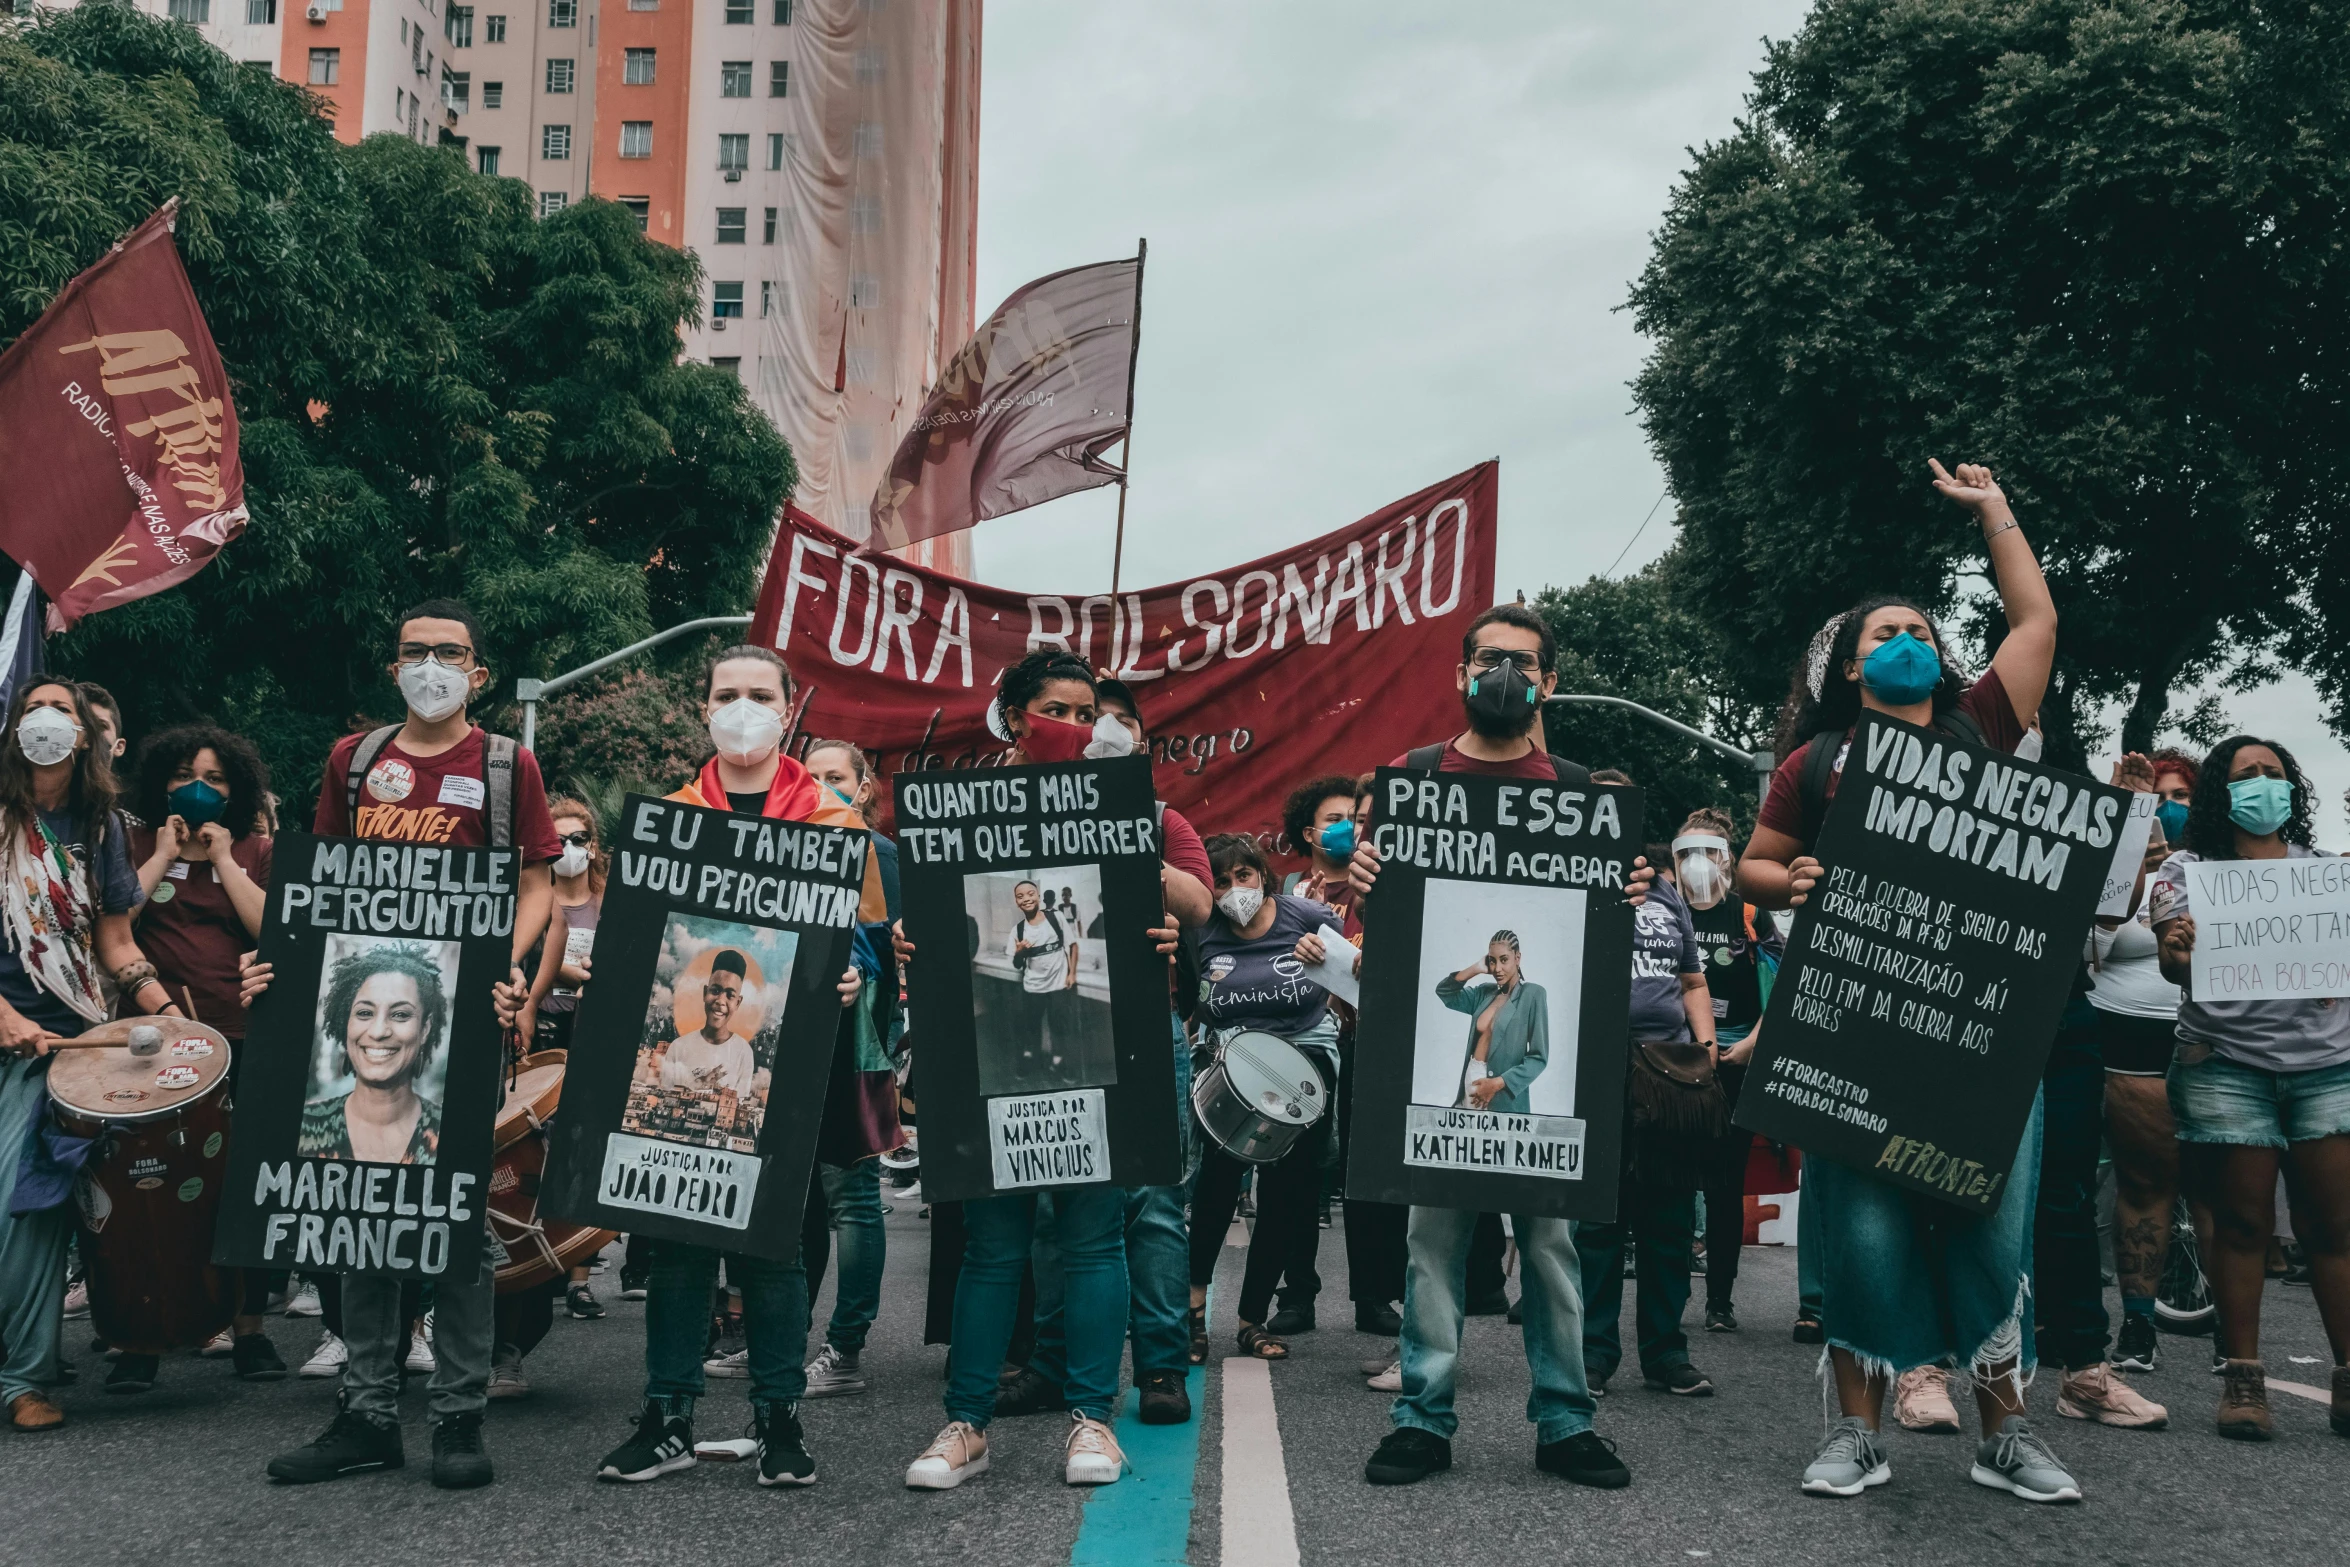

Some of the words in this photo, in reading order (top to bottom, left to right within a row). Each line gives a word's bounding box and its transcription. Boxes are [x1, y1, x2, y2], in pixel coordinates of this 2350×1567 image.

[140, 505, 171, 534] NAS
[775, 532, 974, 687] FORA
[1026, 498, 1468, 681] BOLSONARO
[382, 759, 412, 781] FORA
[1145, 726, 1255, 776] negro
[903, 777, 1028, 820] QUANTOS
[1039, 773, 1100, 814] MAIS
[1865, 721, 1972, 801] VIDAS
[1972, 760, 2119, 848] NEGRAS
[2129, 797, 2153, 818] EU
[1497, 785, 1621, 840] ESSA
[632, 801, 704, 850] EU
[727, 818, 867, 882] TAMBÉM
[899, 827, 965, 864] TEM
[974, 824, 1032, 863] QUE
[1040, 817, 1156, 857] MORRER
[1373, 823, 1497, 875] GUERRA
[1505, 851, 1624, 891] ACABAR
[1863, 785, 2071, 892] IMPORTAM
[311, 841, 512, 893] MARIELLE
[621, 850, 692, 896] VOU
[696, 864, 861, 930] PERGUNTAR
[2198, 867, 2279, 907] VIDAS
[281, 881, 516, 936] PERGUNTOU
[1821, 890, 1893, 933] OPERAÇÕES
[1896, 915, 1912, 940] DA
[1916, 923, 1952, 951] PF-RJ
[1828, 865, 1868, 899] PELA
[1875, 881, 1930, 922] QUEBRA
[1935, 900, 1957, 929] DE
[1960, 909, 2010, 945] SIGILO
[2014, 925, 2047, 960] DAS
[1643, 937, 1677, 949] uma
[1809, 922, 1964, 998] DESMILITARIZAÇÃO
[1974, 977, 2009, 1015] JÁ!
[2209, 963, 2264, 996] FORA
[1207, 975, 1314, 1018] feminista
[1791, 993, 1842, 1033] POBRES
[1797, 964, 1833, 999] PELO
[1836, 977, 1867, 1012] FIM
[1871, 989, 1892, 1022] DA
[1899, 999, 1954, 1043] GUERRA
[1958, 1020, 1994, 1055] AOS
[179, 1038, 208, 1048] FORA
[165, 1066, 194, 1076] FORA
[1772, 1055, 1869, 1105] #FORACASTRO
[1062, 1098, 1087, 1114] POR
[1437, 1110, 1500, 1132] JUSTIÇA
[1507, 1117, 1530, 1133] POR
[1764, 1080, 1889, 1134] #FORABOLSONARO
[1003, 1116, 1082, 1147] MARCUS
[1412, 1132, 1506, 1167] KATHLEN
[1514, 1139, 1579, 1173] ROMEU
[128, 1164, 168, 1176] BOLSONARO
[135, 1157, 159, 1168] FORA
[640, 1146, 702, 1173] JUSTIÇA
[707, 1156, 733, 1176] POR
[1006, 1143, 1094, 1183] VINICIUS
[254, 1161, 477, 1223] MARIELLE
[488, 1179, 516, 1194] FRANCO
[608, 1162, 667, 1206] JOÃO
[673, 1175, 738, 1220] PEDRO
[263, 1213, 450, 1275] FRANCO
